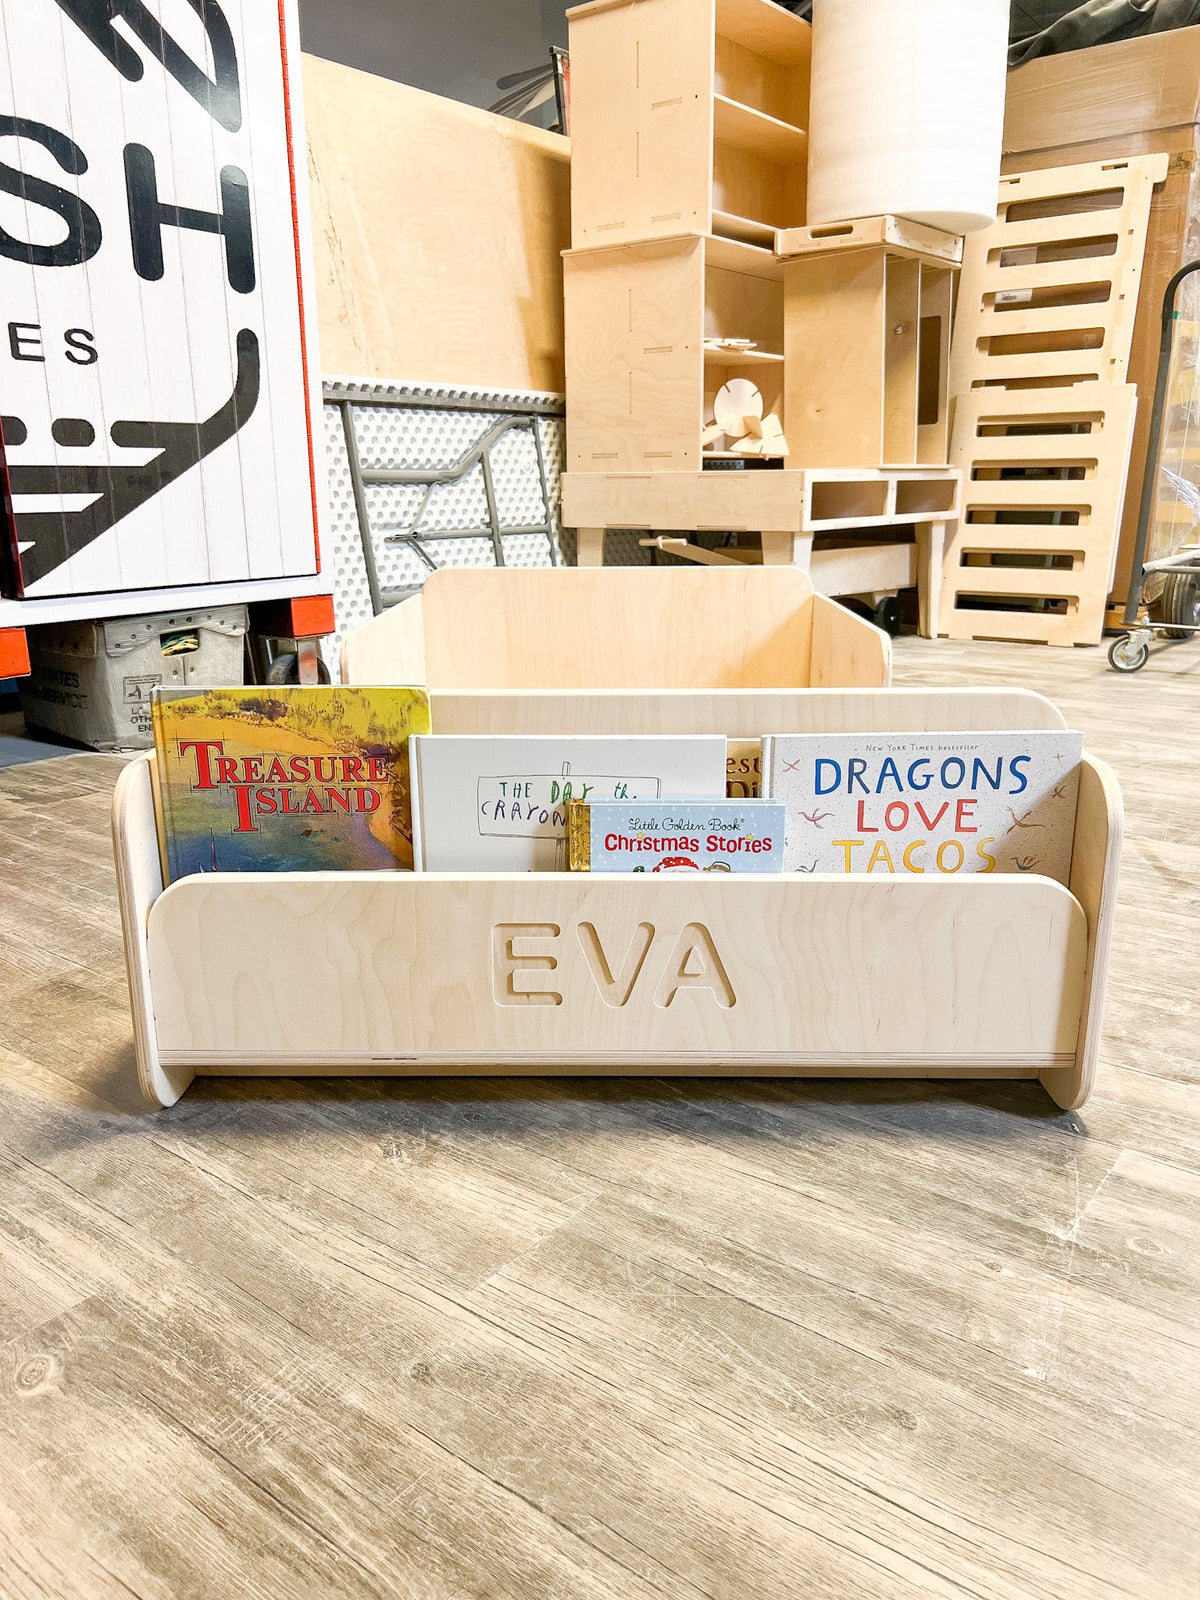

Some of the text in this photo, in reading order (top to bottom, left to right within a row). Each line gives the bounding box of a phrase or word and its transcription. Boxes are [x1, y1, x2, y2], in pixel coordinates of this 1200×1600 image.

[179, 741, 390, 789] TREASURE
[938, 744, 979, 752] bestseller
[499, 782, 533, 798] THE
[550, 780, 594, 804] DAY
[815, 755, 1032, 795] DRAGONS
[233, 784, 382, 833] ISLAND
[628, 817, 661, 832] Little
[661, 818, 706, 832] Golden
[856, 798, 979, 833] LOVE
[604, 833, 773, 854] Christmas Stories
[831, 837, 996, 873] TACOS
[490, 921, 738, 1009] EVA
